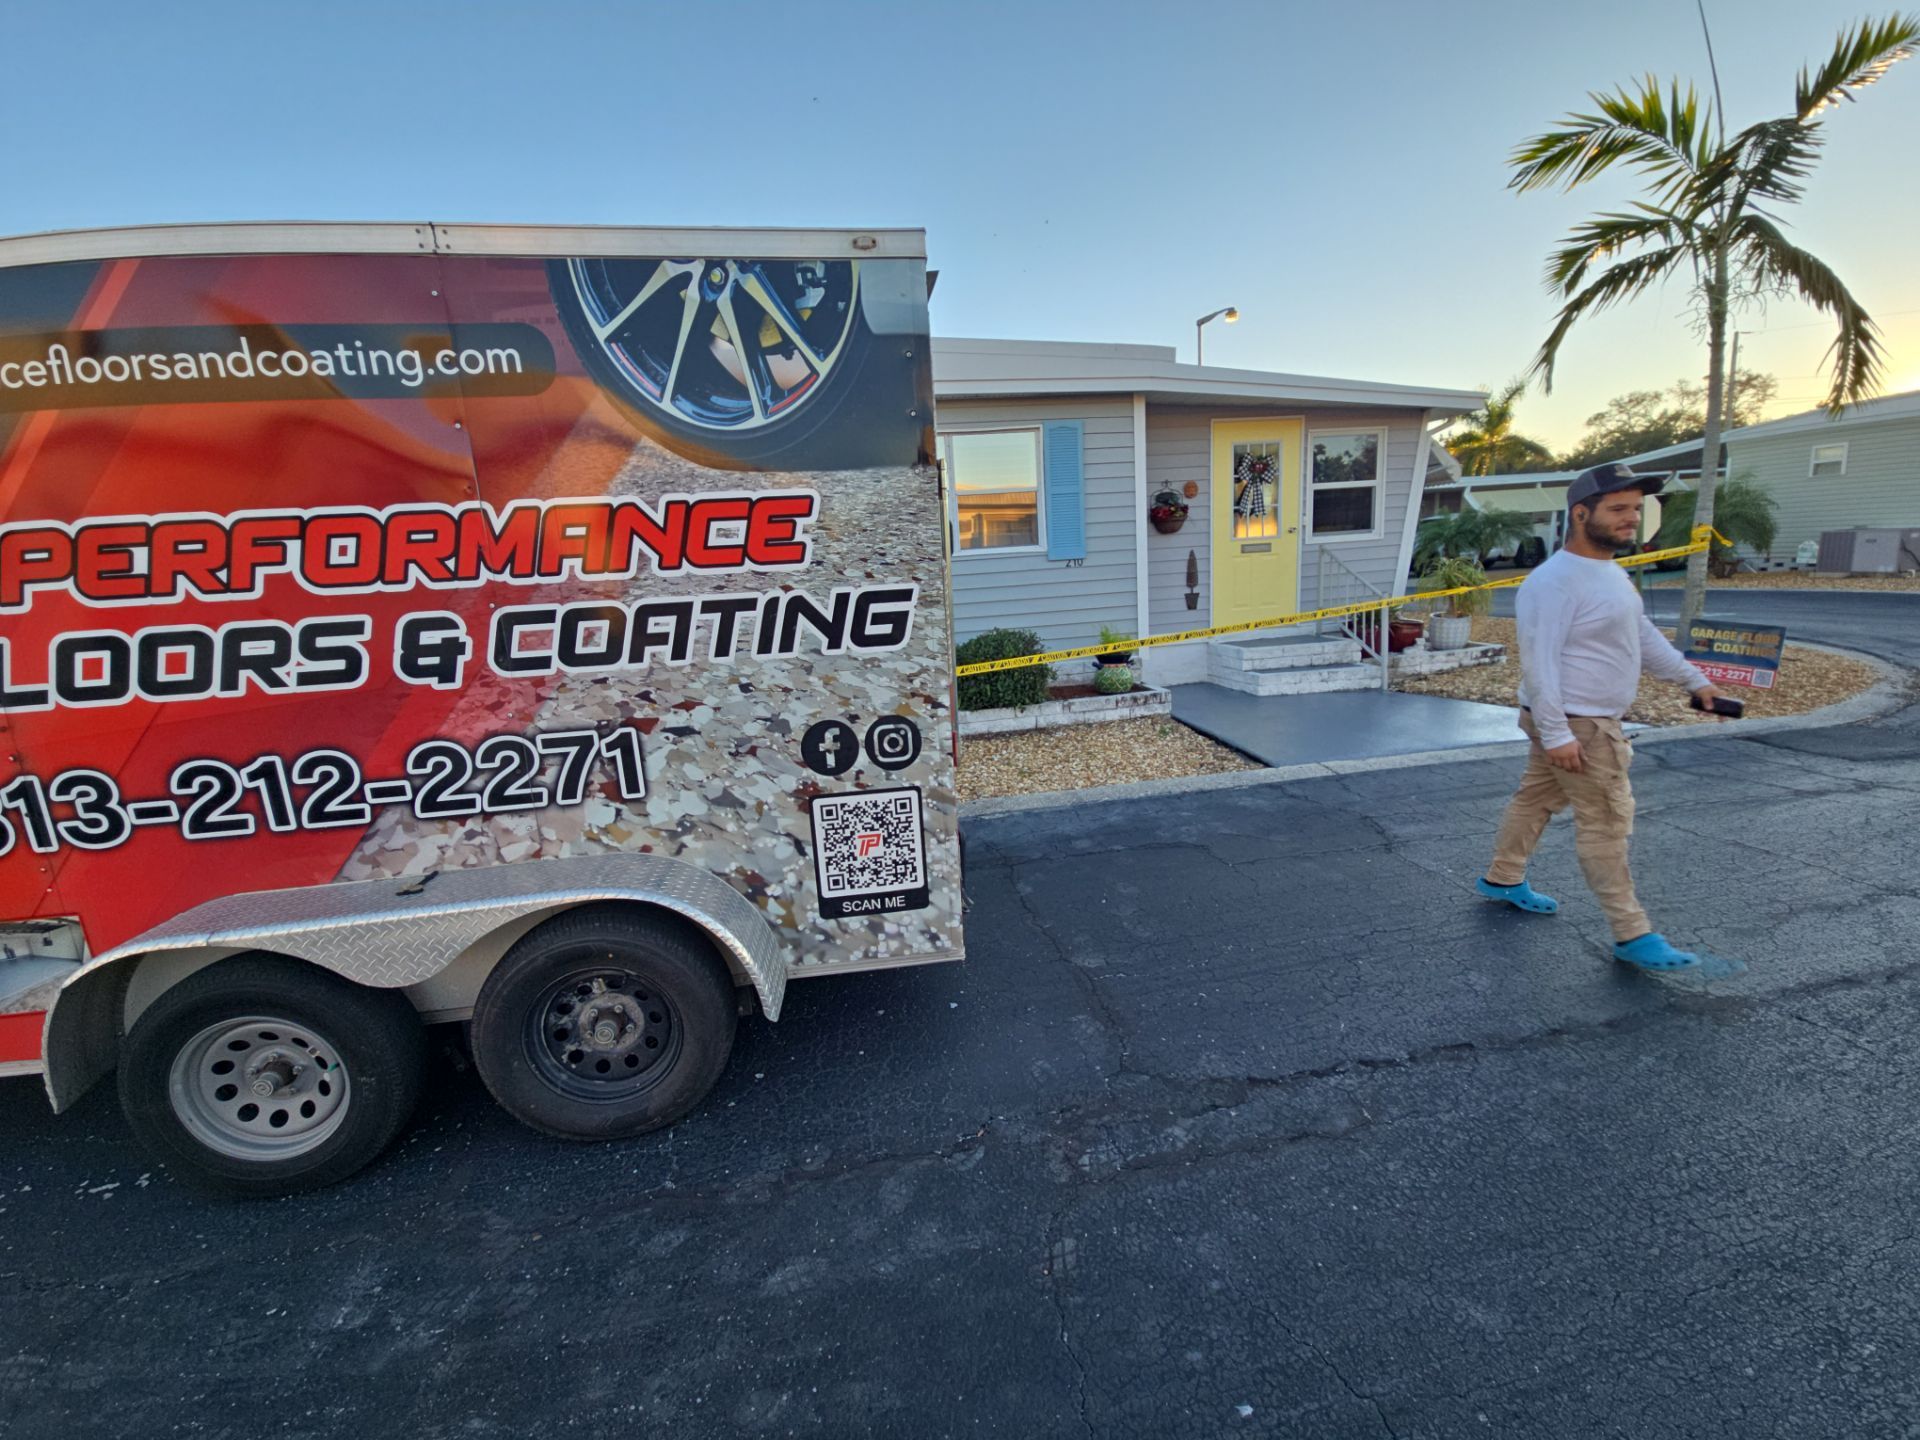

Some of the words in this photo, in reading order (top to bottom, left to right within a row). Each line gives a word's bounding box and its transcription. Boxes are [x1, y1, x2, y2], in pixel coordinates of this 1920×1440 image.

[0, 337, 523, 388] cefloorsandcoating.com
[0, 489, 820, 614] PERFORMANCE
[1065, 558, 1084, 568] 210
[0, 615, 372, 713] LOORS
[395, 610, 473, 690] &
[493, 587, 920, 677] COATING
[1690, 627, 1737, 641] GARAGE
[0, 727, 646, 856] 13-212-2271
[842, 899, 881, 912] SCAN
[885, 896, 906, 908] ME
